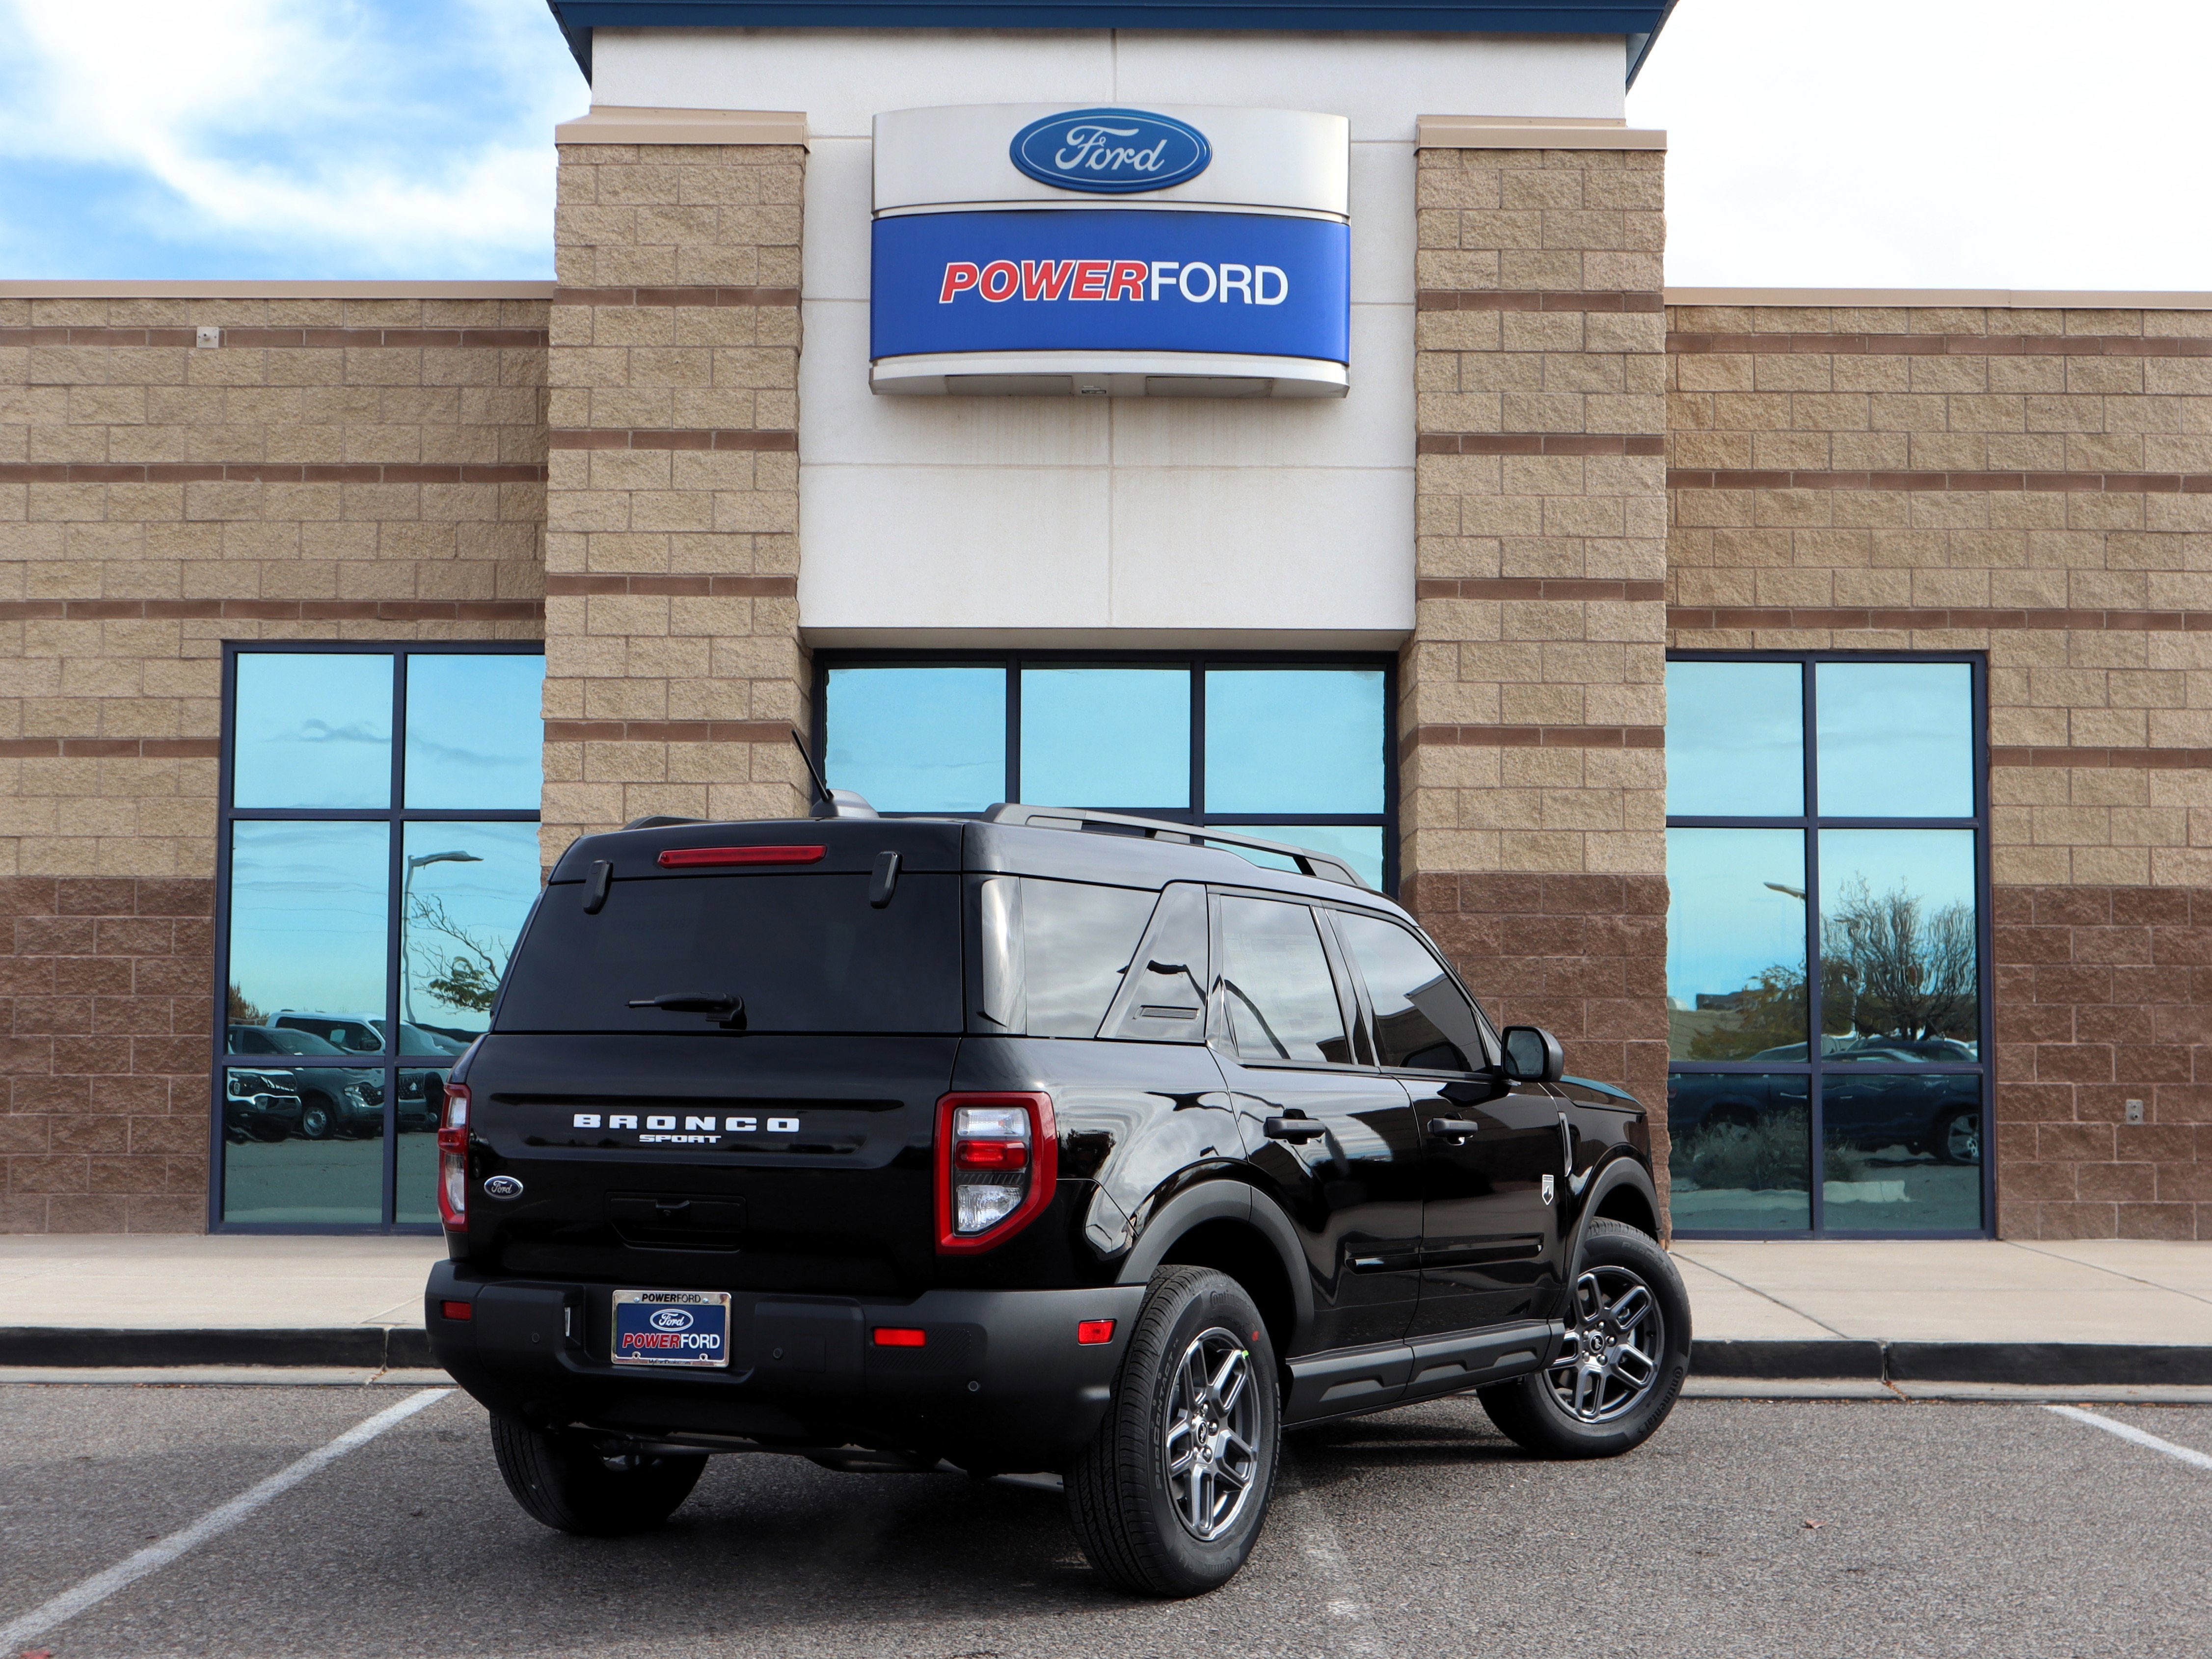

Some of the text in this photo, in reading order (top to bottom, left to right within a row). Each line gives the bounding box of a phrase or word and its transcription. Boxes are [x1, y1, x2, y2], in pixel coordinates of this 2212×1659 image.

[1055, 125, 1167, 171] Ford
[573, 1114, 800, 1132] BRONCO
[639, 1134, 722, 1144] SPORT
[491, 1180, 512, 1194] Ford
[659, 1313, 685, 1326] Ford
